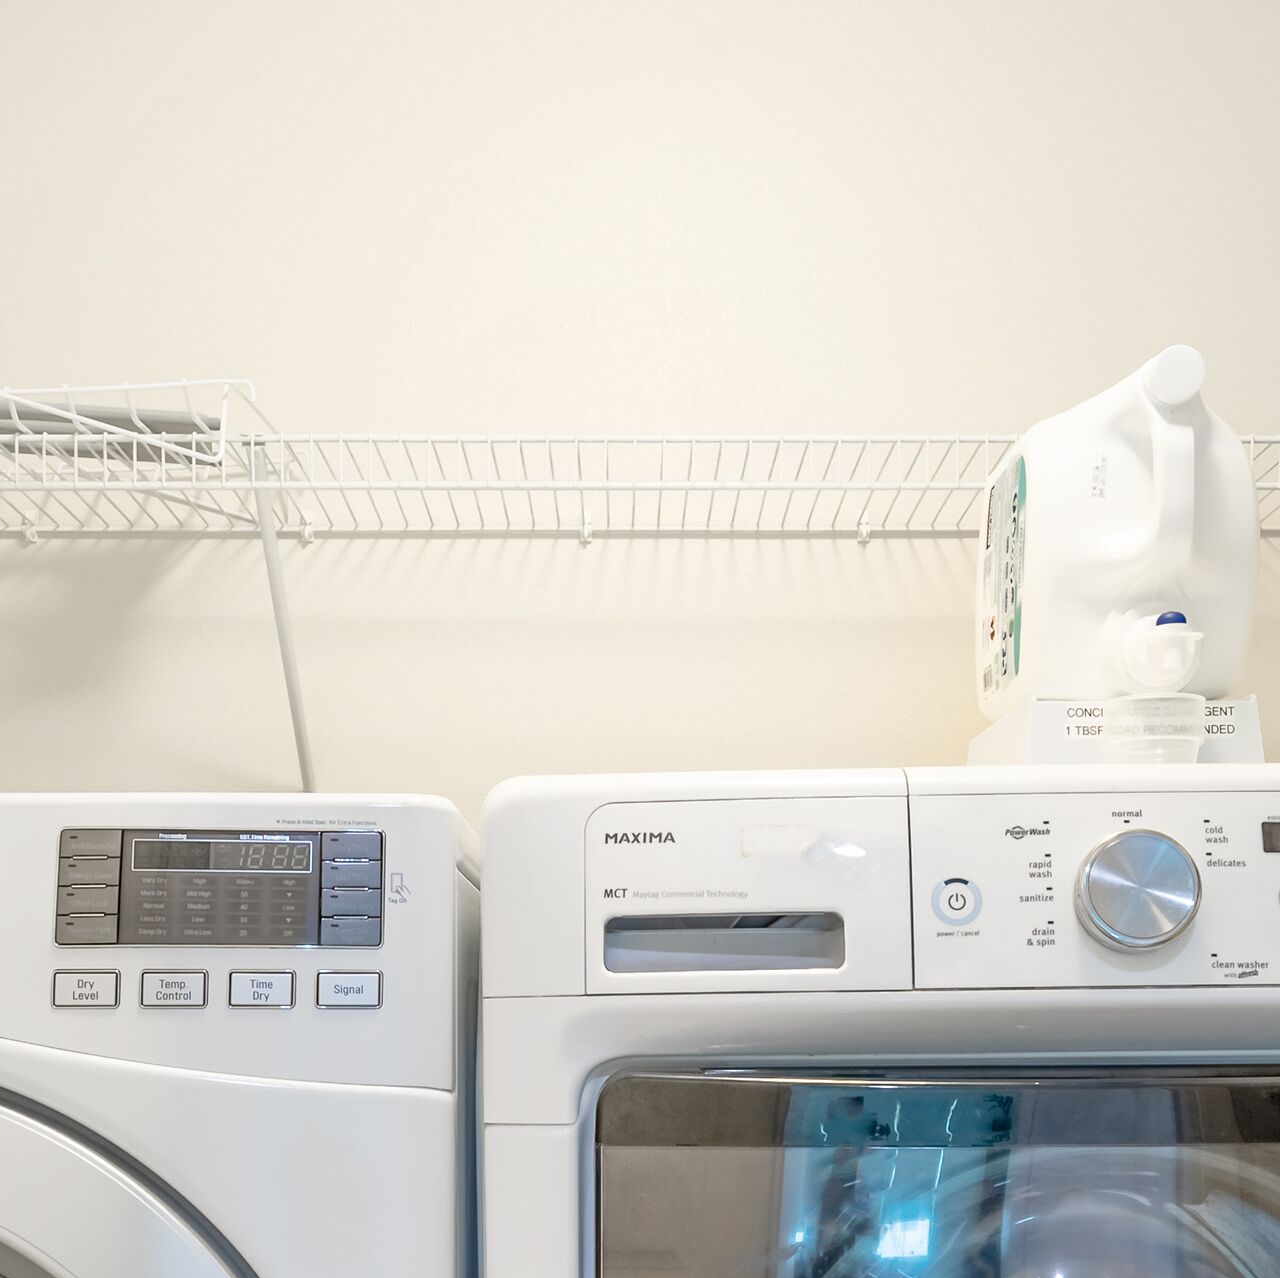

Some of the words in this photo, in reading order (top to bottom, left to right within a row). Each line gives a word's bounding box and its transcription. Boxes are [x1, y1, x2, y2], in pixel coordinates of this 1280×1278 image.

[1112, 809, 1142, 818] normal
[1005, 828, 1050, 836] PowerWash
[605, 832, 676, 844] MAXIMA
[1029, 860, 1051, 869] rapid
[1207, 859, 1246, 867] delicates
[603, 888, 628, 899] MCT
[632, 890, 660, 899] Maytag
[661, 890, 705, 898] Commercial
[706, 889, 749, 899] Technology
[1020, 894, 1054, 902] sanitize
[1037, 939, 1055, 947] spin
[77, 979, 94, 990] Dry
[160, 979, 185, 990] Temp
[250, 979, 273, 989] Time
[334, 985, 364, 995] Signal
[73, 991, 98, 1000] Level
[156, 991, 191, 1000] Control
[253, 991, 270, 1001] Dry
